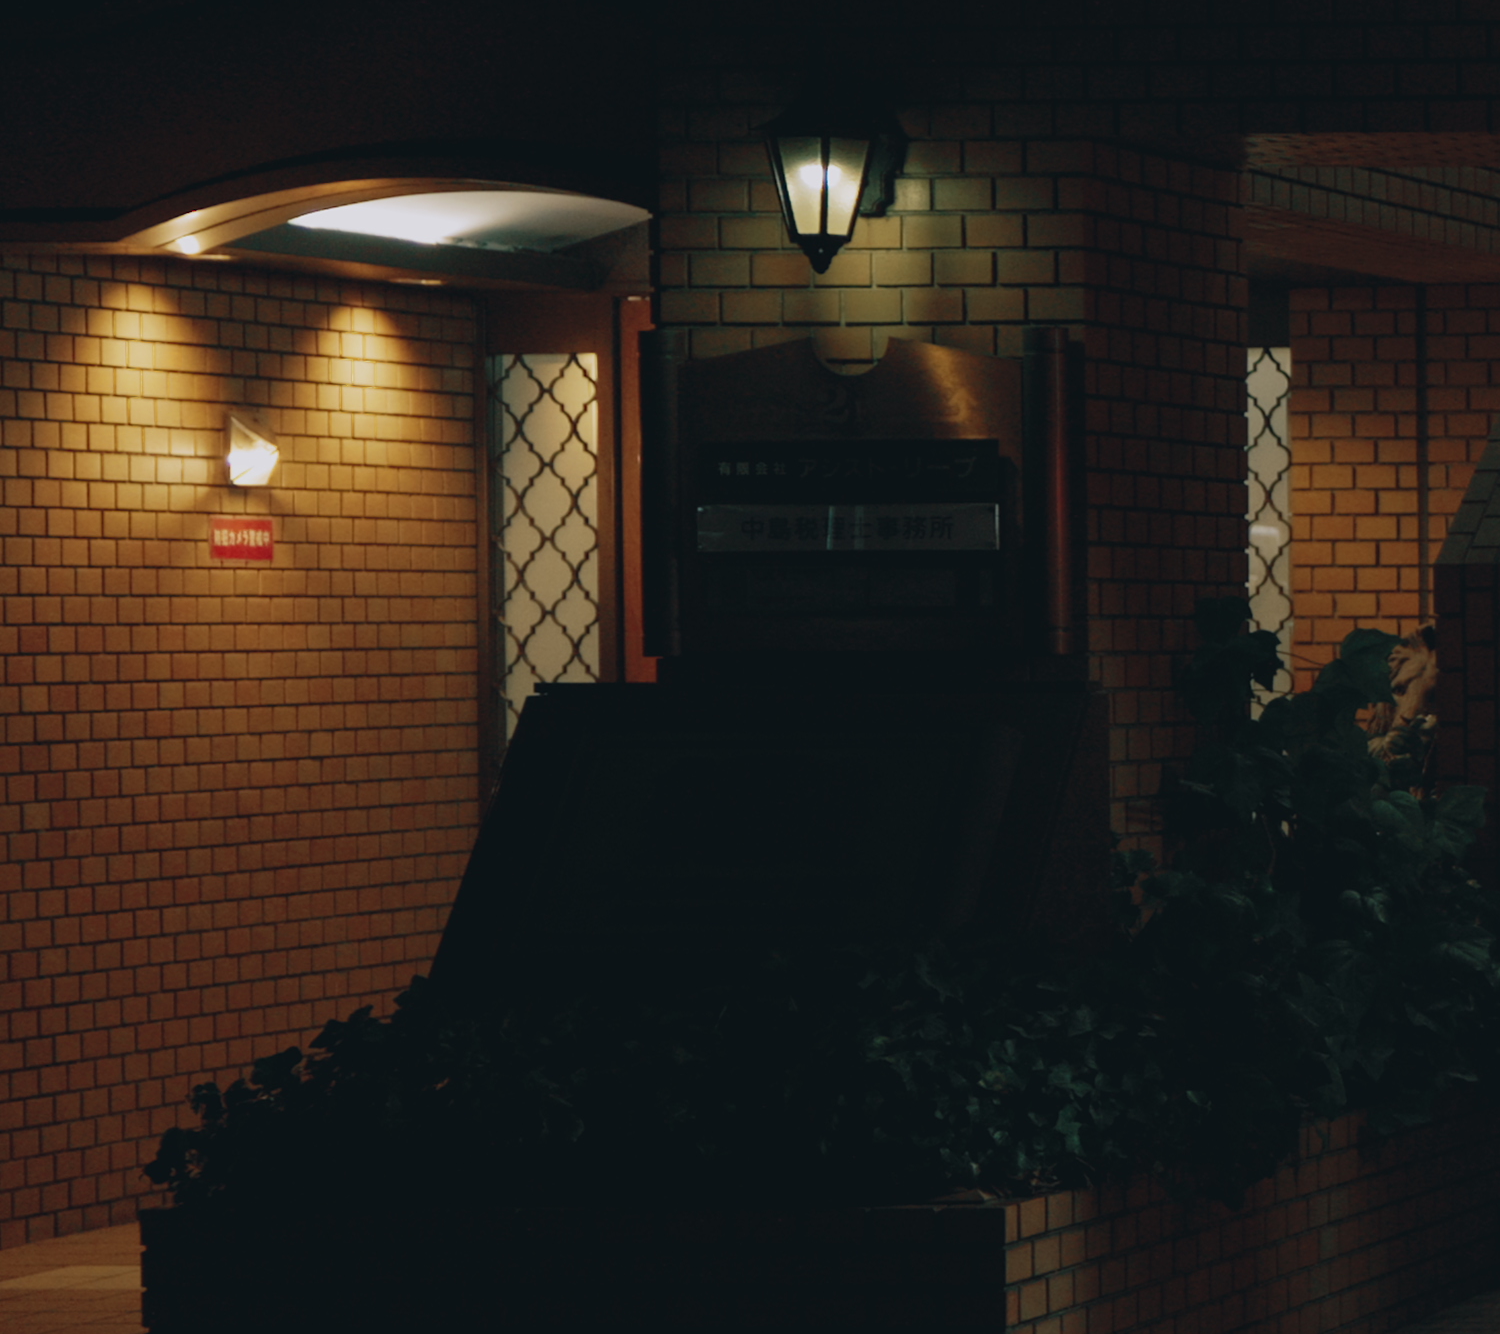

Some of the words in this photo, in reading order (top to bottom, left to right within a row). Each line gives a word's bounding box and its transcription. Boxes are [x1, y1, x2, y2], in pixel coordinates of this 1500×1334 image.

[741, 515, 954, 541] 中島税理士事務所
